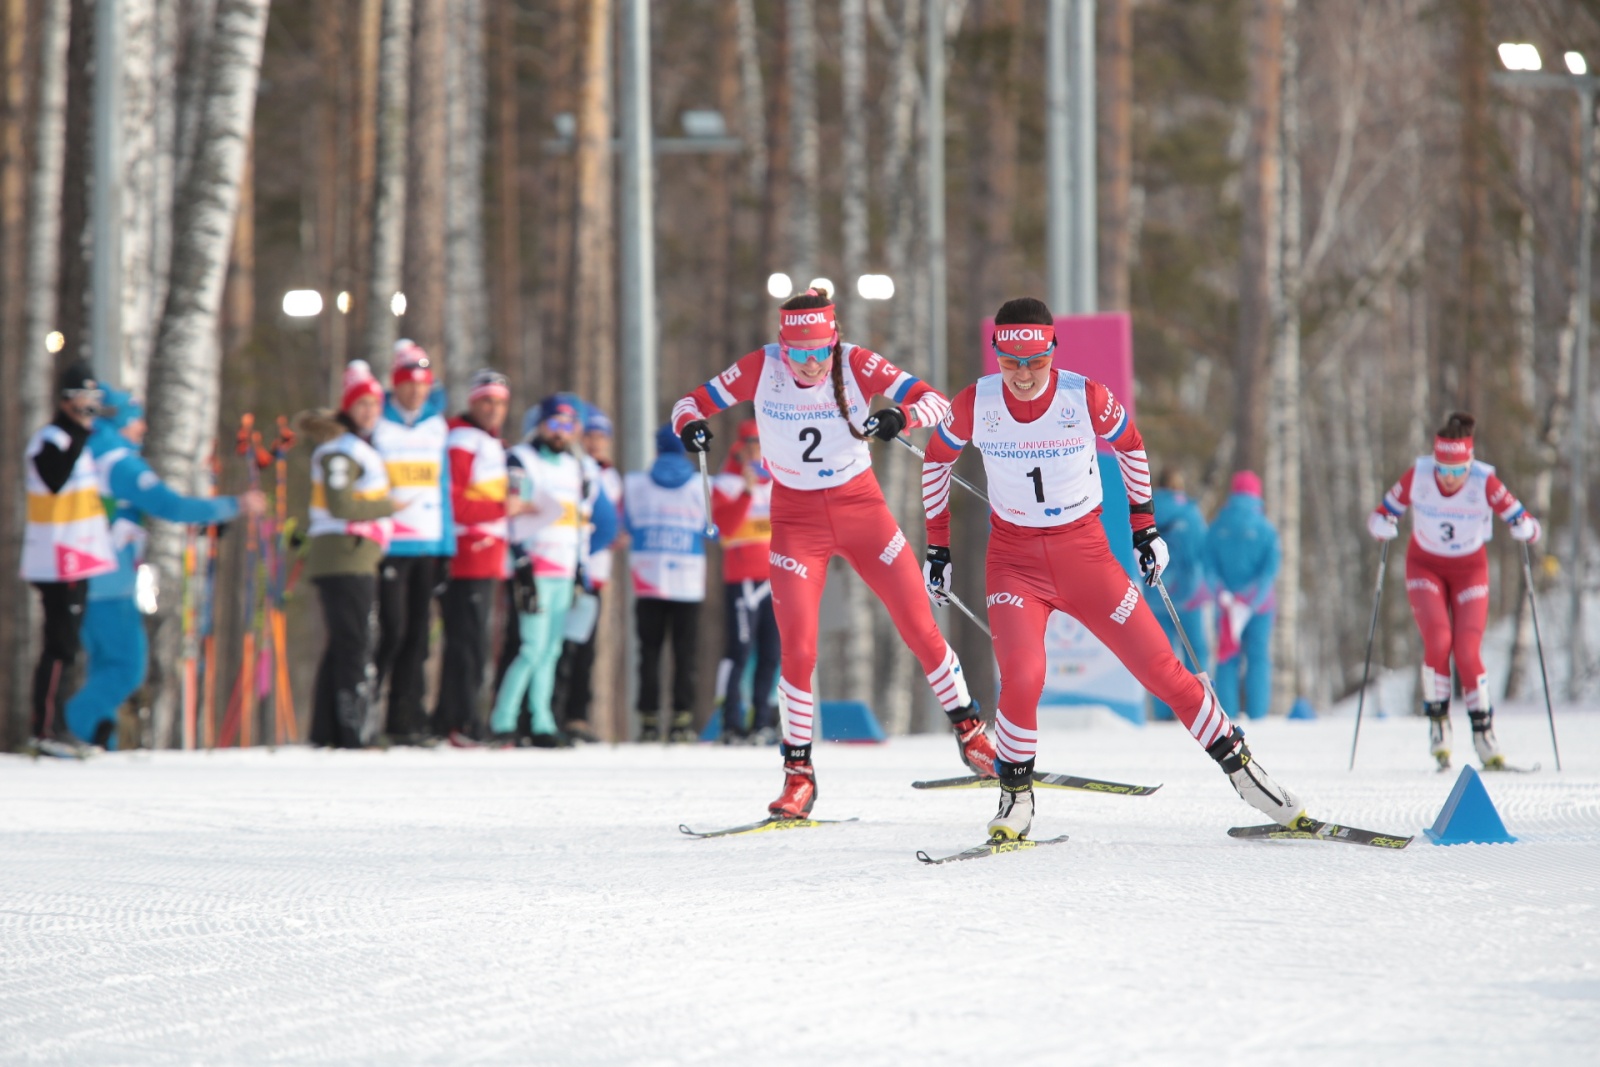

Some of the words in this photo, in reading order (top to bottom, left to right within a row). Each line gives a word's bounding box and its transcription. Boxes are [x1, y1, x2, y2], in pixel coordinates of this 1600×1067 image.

[785, 312, 827, 326] LUKOIL
[997, 328, 1045, 341] LUKOIL
[798, 426, 823, 463] 2
[979, 441, 1017, 450] WINTER
[1018, 437, 1084, 449] UNIVERSIADE
[1062, 445, 1086, 457] 2019
[1026, 467, 1046, 503] 1
[1439, 521, 1455, 543] 3
[769, 551, 808, 579] UKOIL
[986, 592, 1024, 608] UKOIL
[1013, 766, 1027, 775] 101
[1082, 782, 1130, 794] FISCHER
